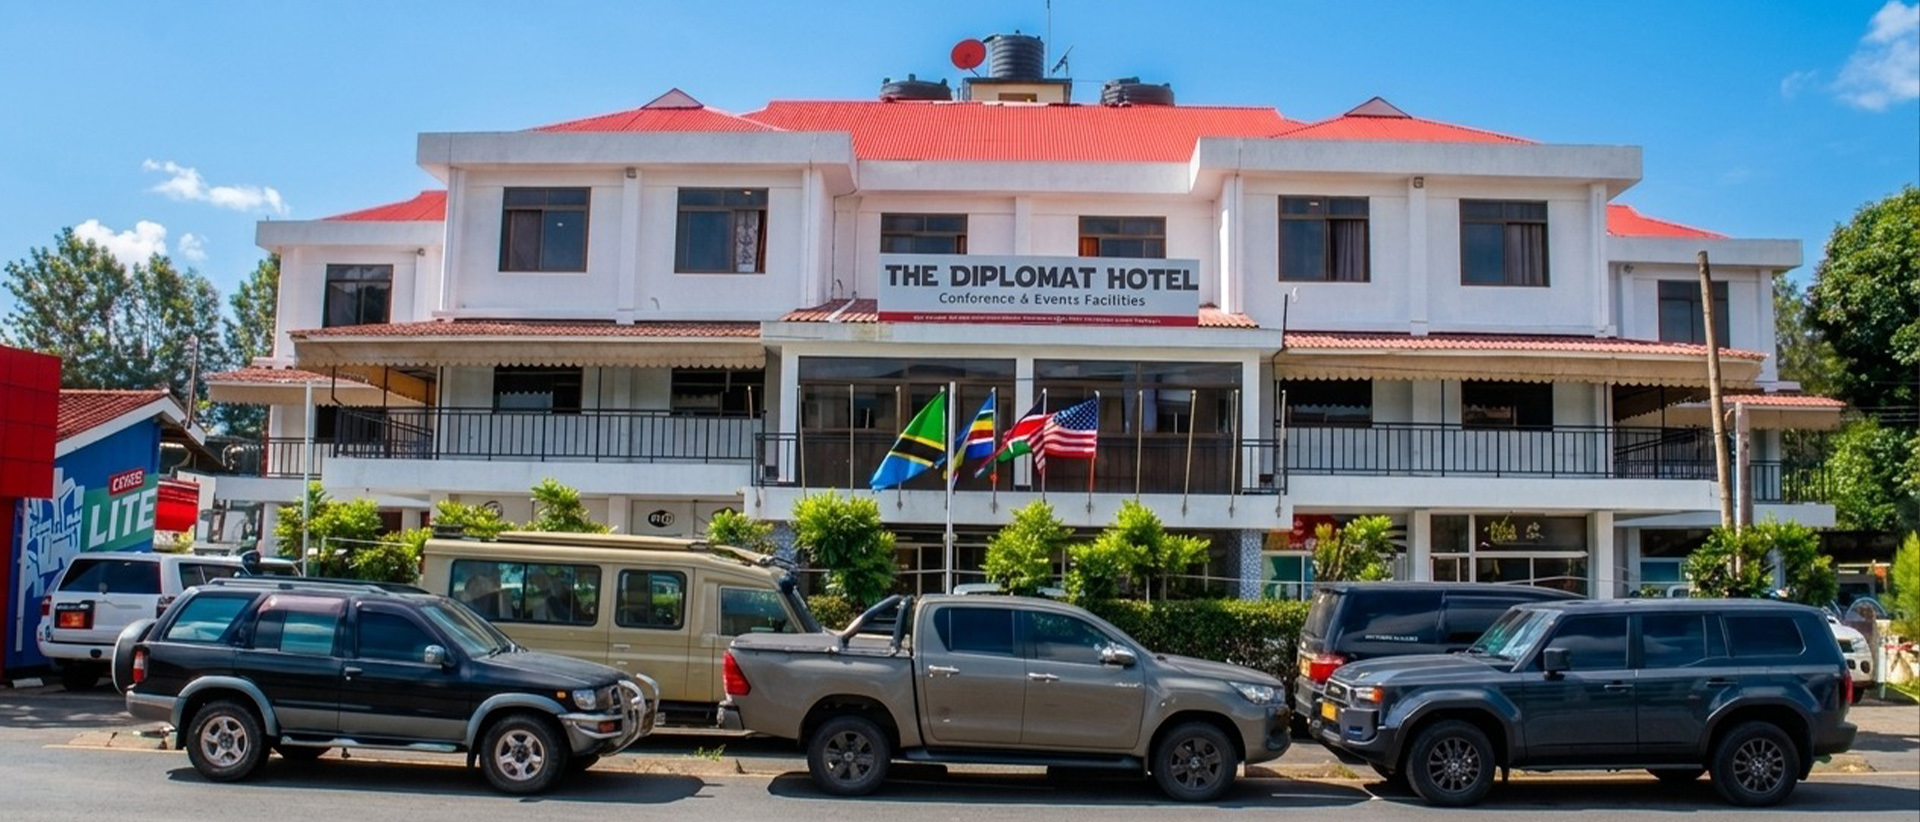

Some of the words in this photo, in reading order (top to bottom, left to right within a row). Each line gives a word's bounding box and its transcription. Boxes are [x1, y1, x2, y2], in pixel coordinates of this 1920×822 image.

[885, 264, 939, 287] THE
[950, 265, 1097, 289] DIPLOMAT
[1107, 267, 1199, 291] HOTEL
[1020, 293, 1030, 305] &
[1034, 294, 1080, 306] Events
[1085, 294, 1146, 307] Facilities
[88, 487, 157, 549] LITE
